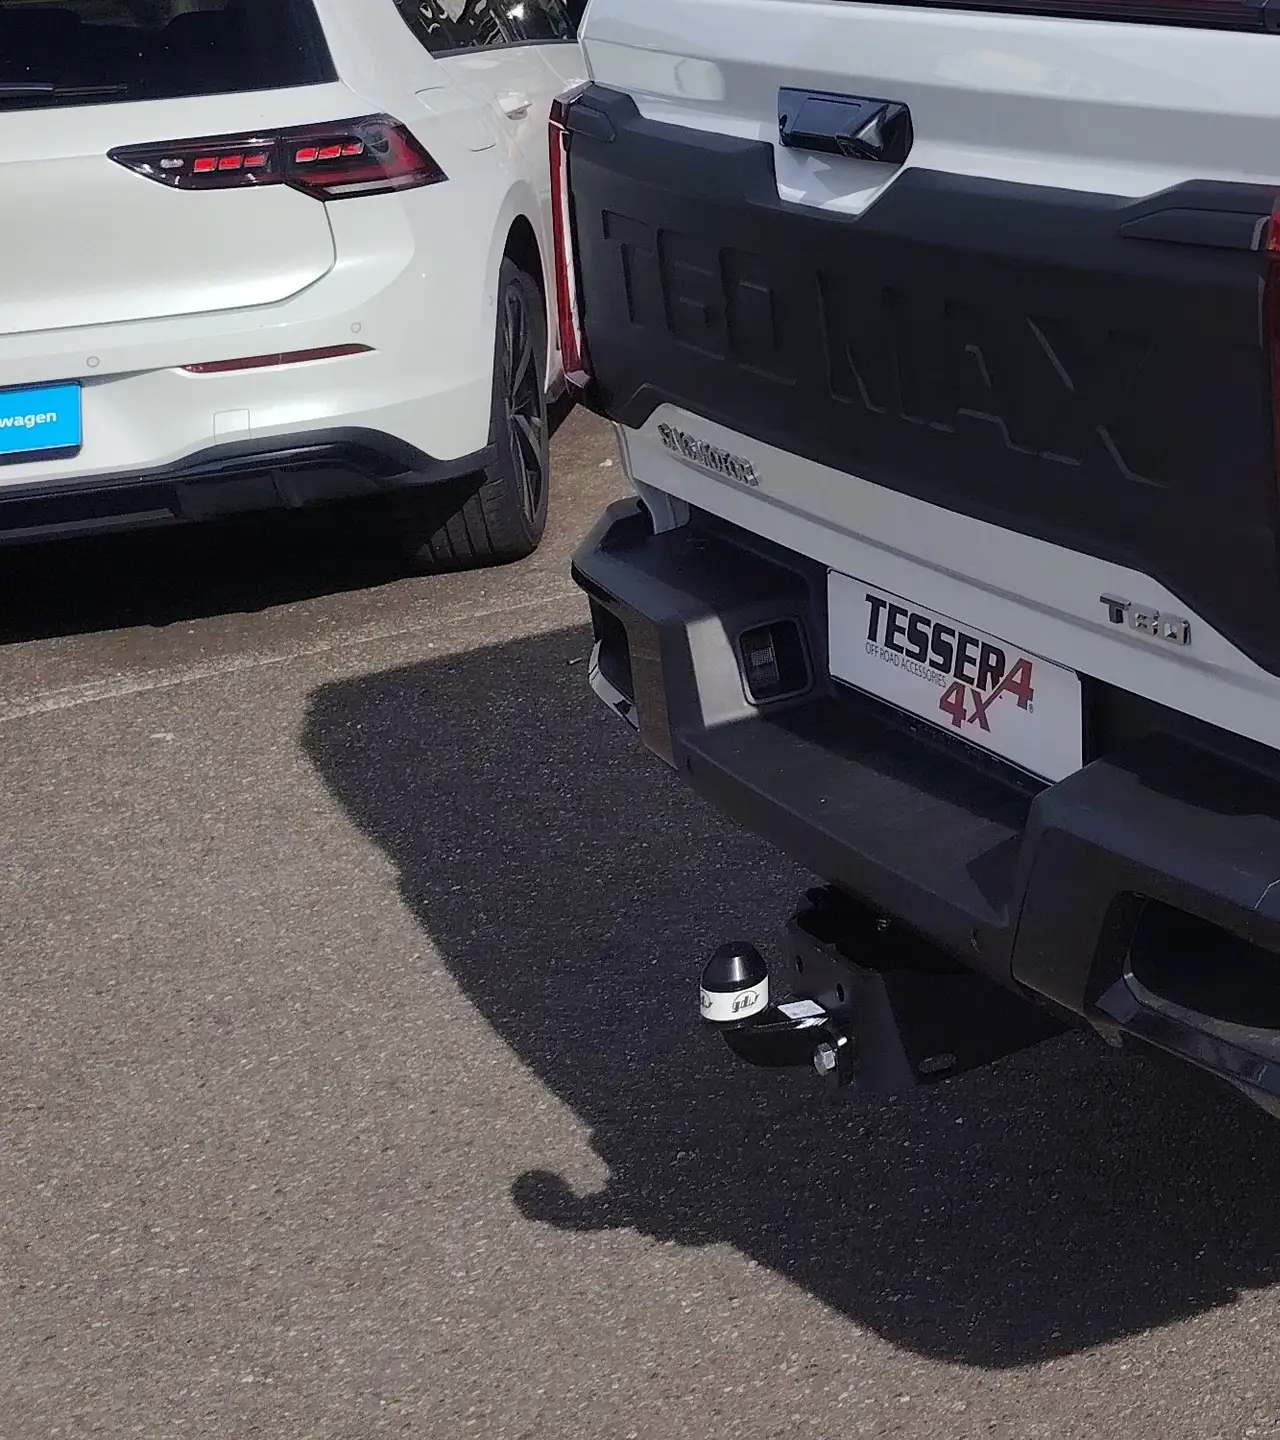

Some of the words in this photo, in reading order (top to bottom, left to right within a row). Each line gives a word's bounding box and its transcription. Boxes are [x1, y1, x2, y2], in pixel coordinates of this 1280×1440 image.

[865, 642, 880, 658] OFF
[880, 647, 899, 667] ROAD
[901, 658, 947, 688] ACCESSORIES
